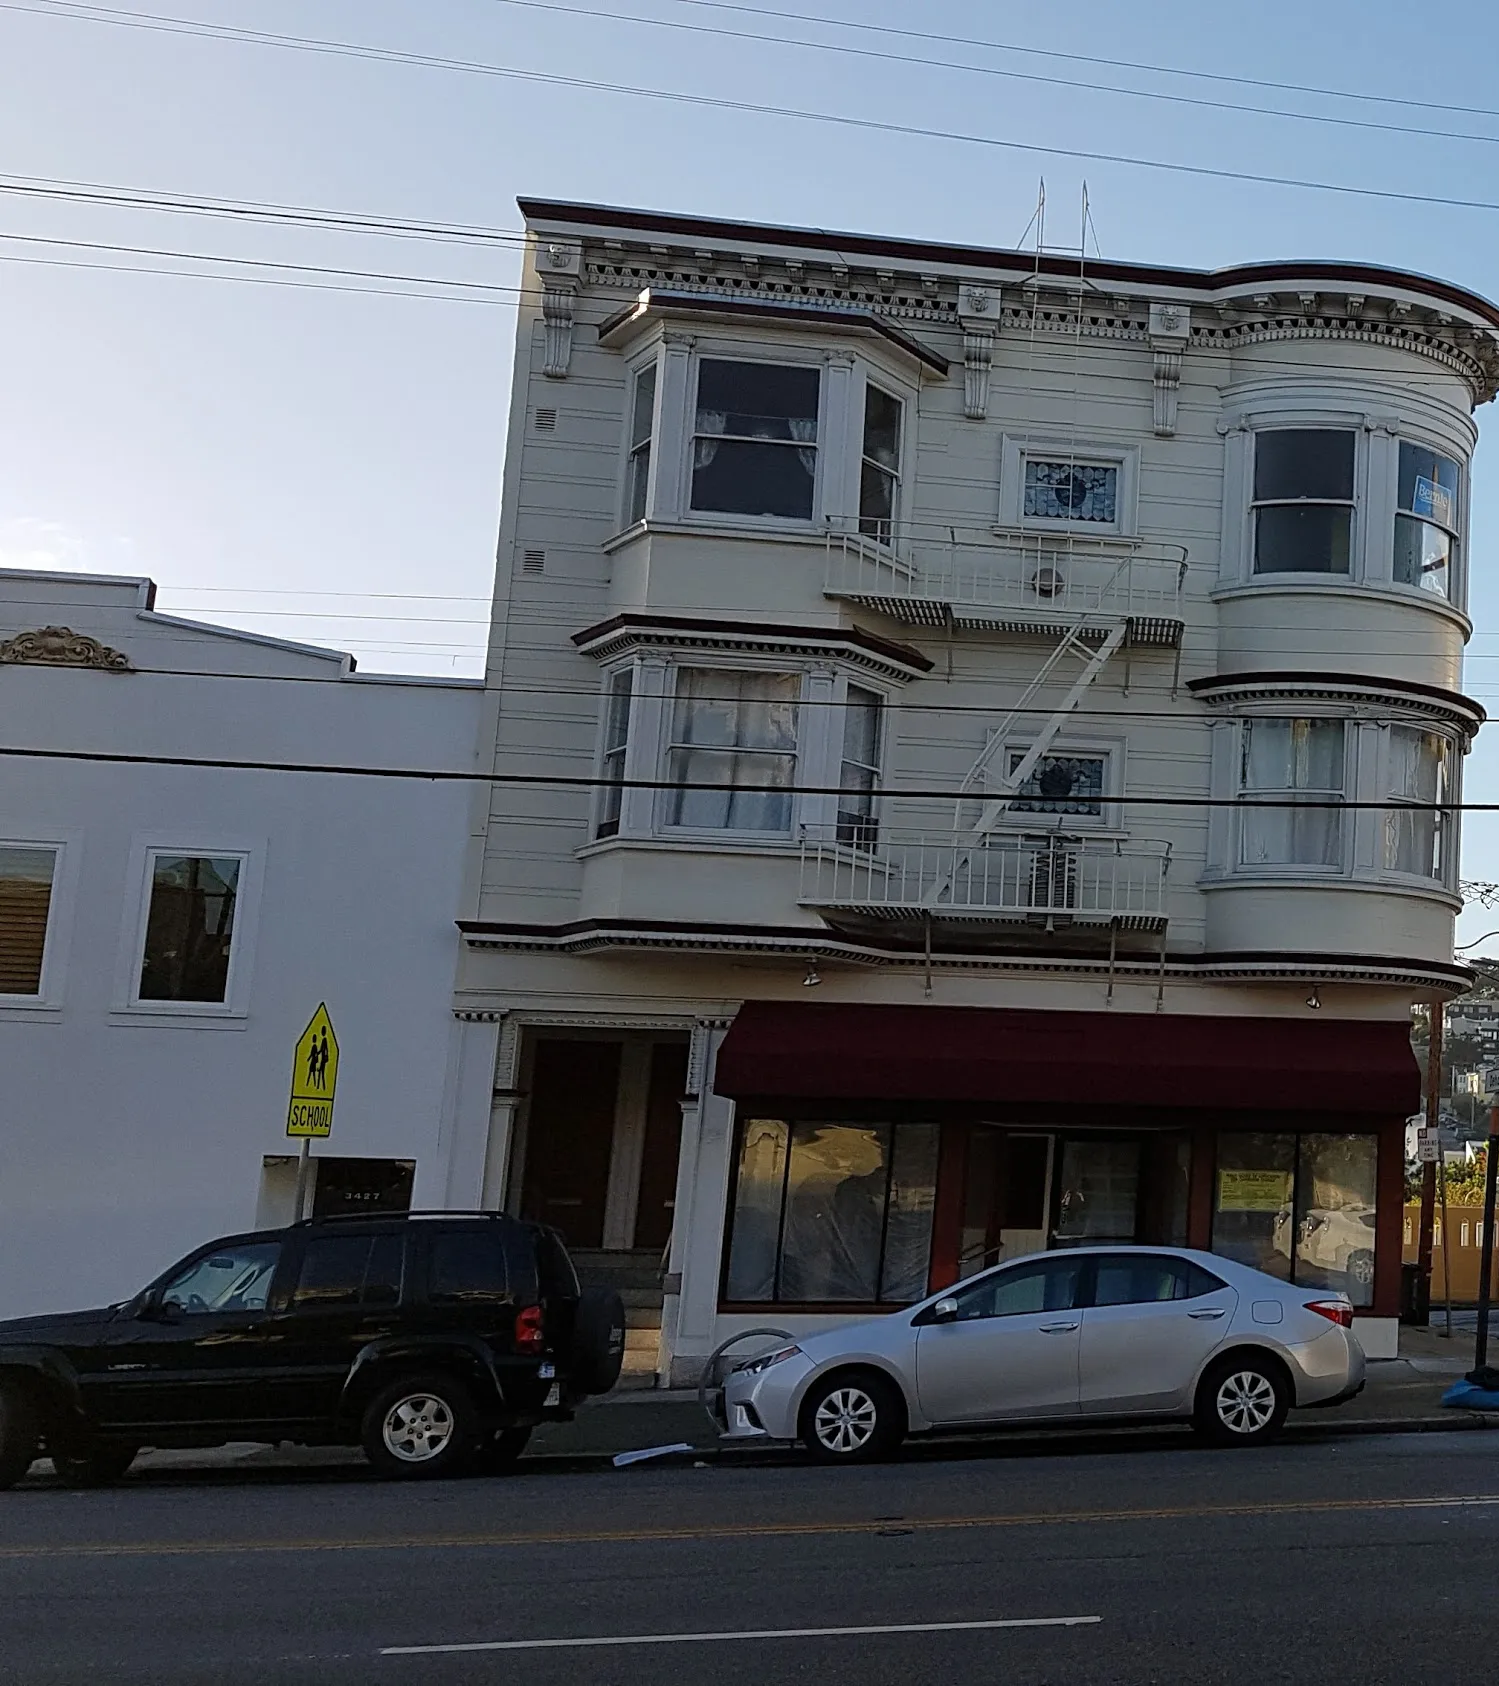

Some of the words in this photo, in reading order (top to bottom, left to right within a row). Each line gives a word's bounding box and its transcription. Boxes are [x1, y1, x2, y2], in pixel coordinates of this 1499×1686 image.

[1419, 484, 1448, 507] Bernie
[291, 1104, 330, 1129] SCHOOL
[344, 1192, 380, 1200] 3427
